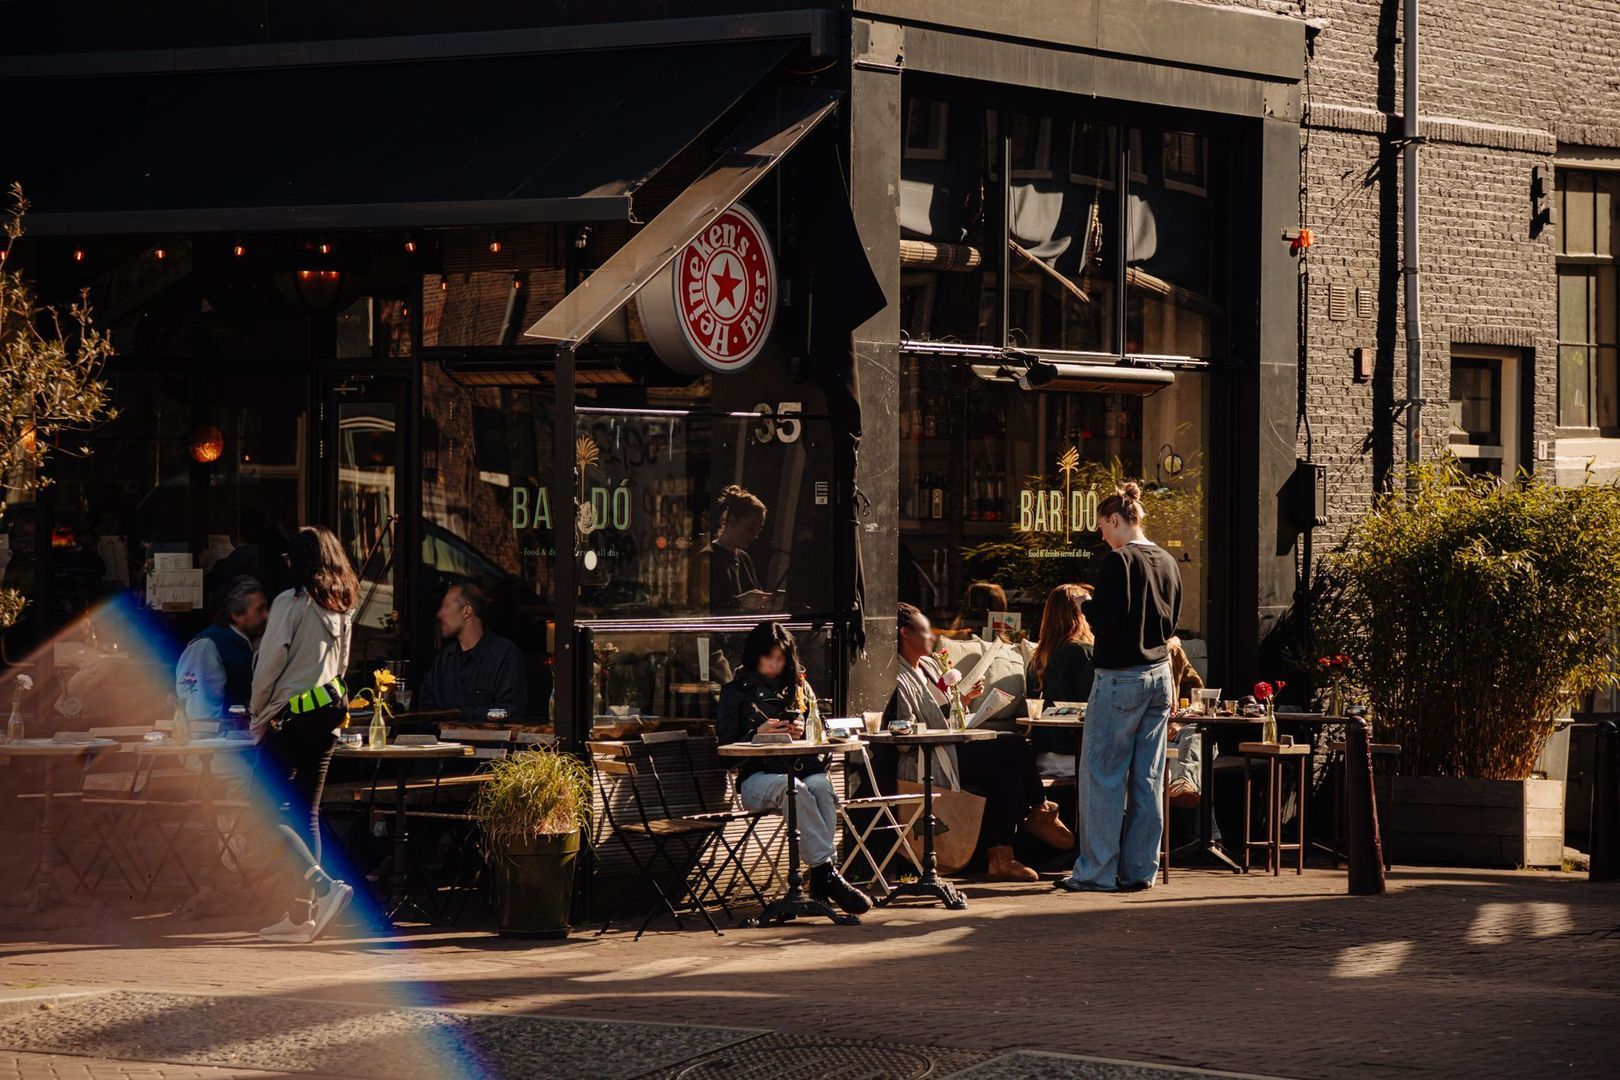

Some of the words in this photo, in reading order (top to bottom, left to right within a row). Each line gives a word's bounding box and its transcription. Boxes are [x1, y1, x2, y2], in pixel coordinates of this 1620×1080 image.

[688, 223, 749, 356] Heineken's
[740, 270, 767, 344] Bier
[753, 402, 802, 444] 35
[512, 487, 554, 530] BA
[1020, 490, 1064, 532] BAR
[1072, 483, 1099, 532] DÓ
[1028, 549, 1040, 558] food
[1083, 549, 1091, 560] day
